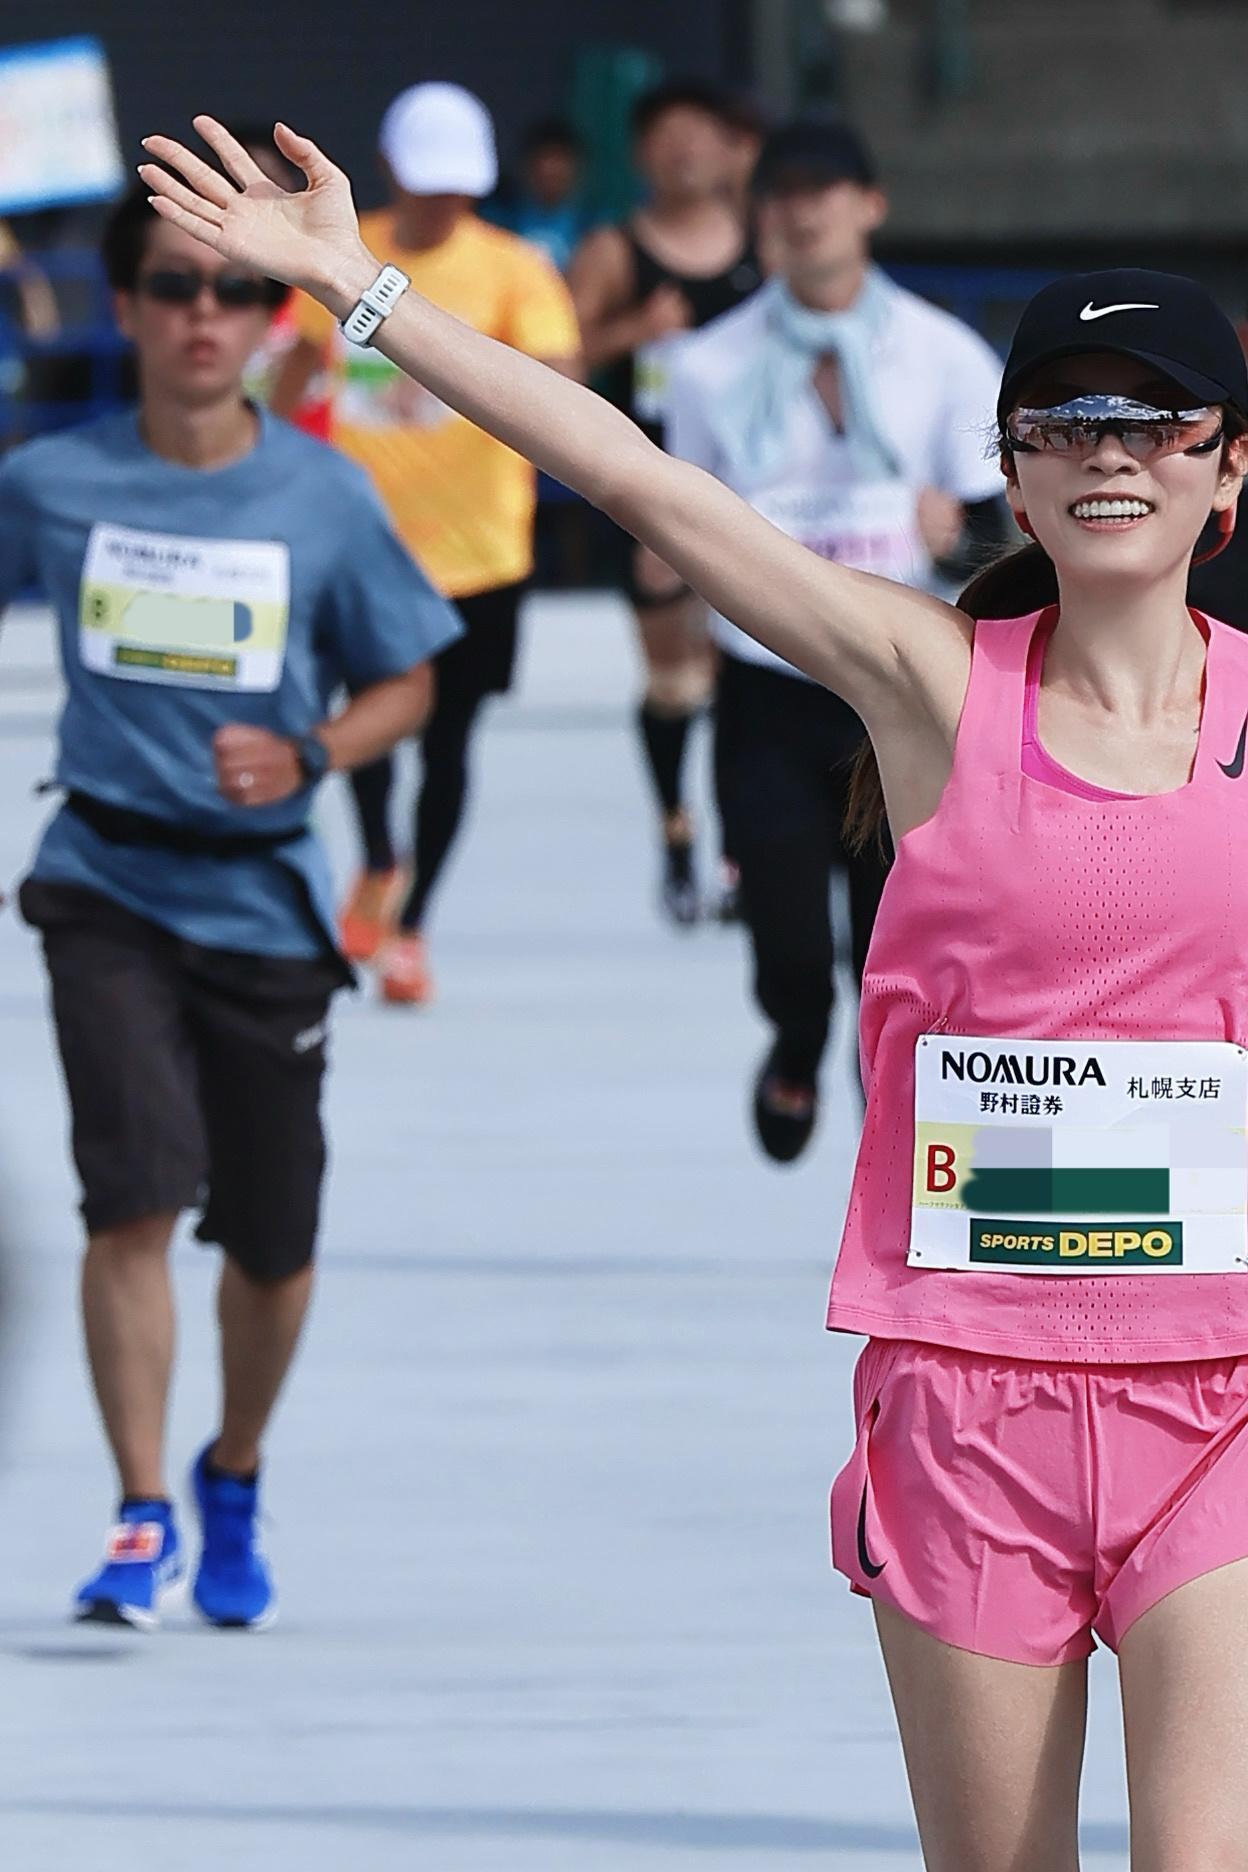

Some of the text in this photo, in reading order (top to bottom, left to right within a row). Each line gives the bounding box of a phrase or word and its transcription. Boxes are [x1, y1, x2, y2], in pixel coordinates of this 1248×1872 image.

[942, 1050, 1107, 1086] NOMURA
[1127, 1076, 1221, 1099] 札幌支店
[980, 1092, 1063, 1116] 野村證券
[926, 1144, 957, 1193] B
[980, 1230, 1173, 1257] SPORTS DEPO
